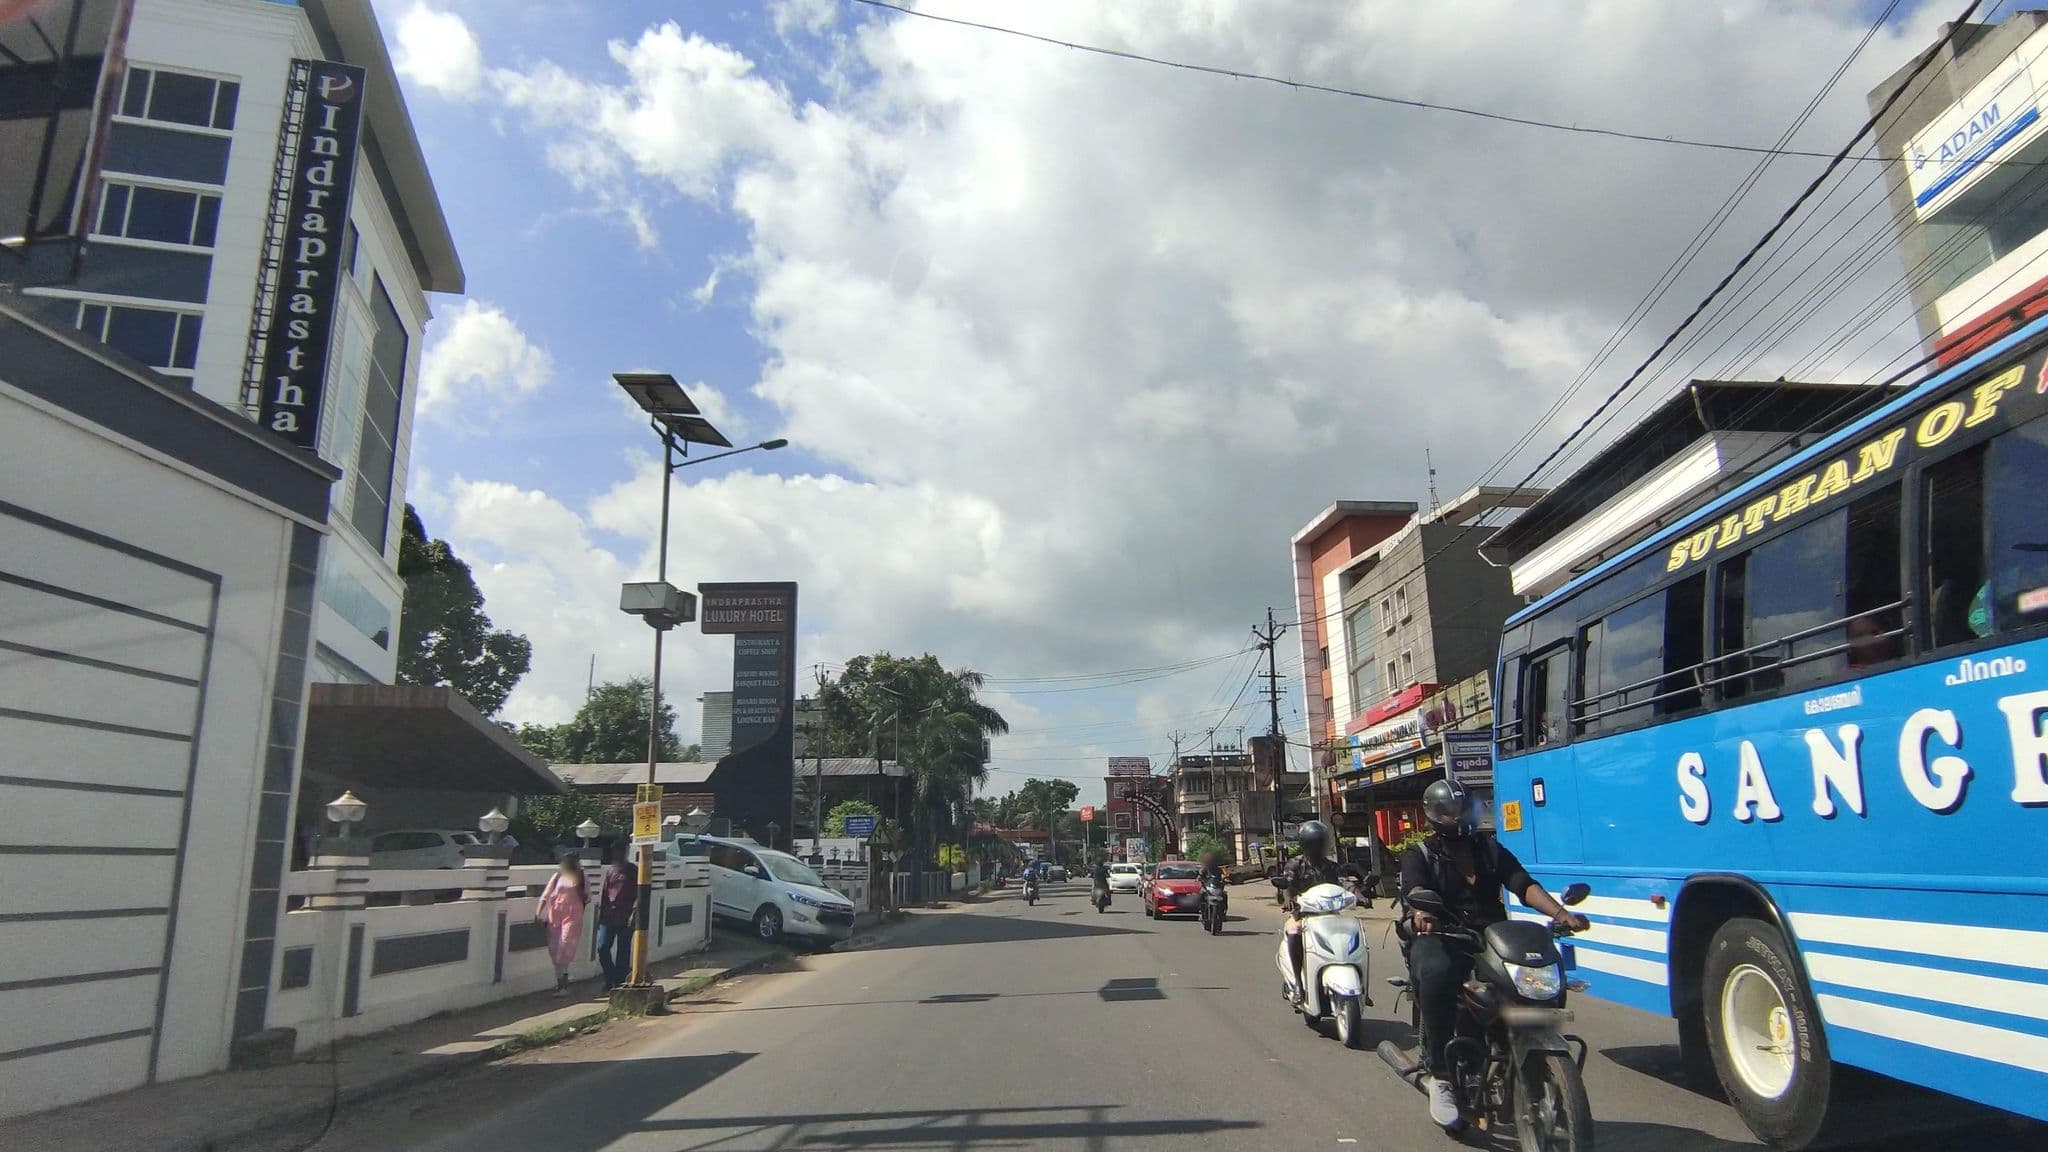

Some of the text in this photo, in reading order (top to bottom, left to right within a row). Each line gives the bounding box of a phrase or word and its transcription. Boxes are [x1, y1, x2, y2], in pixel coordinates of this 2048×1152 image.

[1939, 102, 2001, 165] ADAM
[1667, 364, 2025, 572] SULTHAN OF
[705, 609, 784, 622] LUXURY HOTEL
[1456, 757, 1489, 770] apollo
